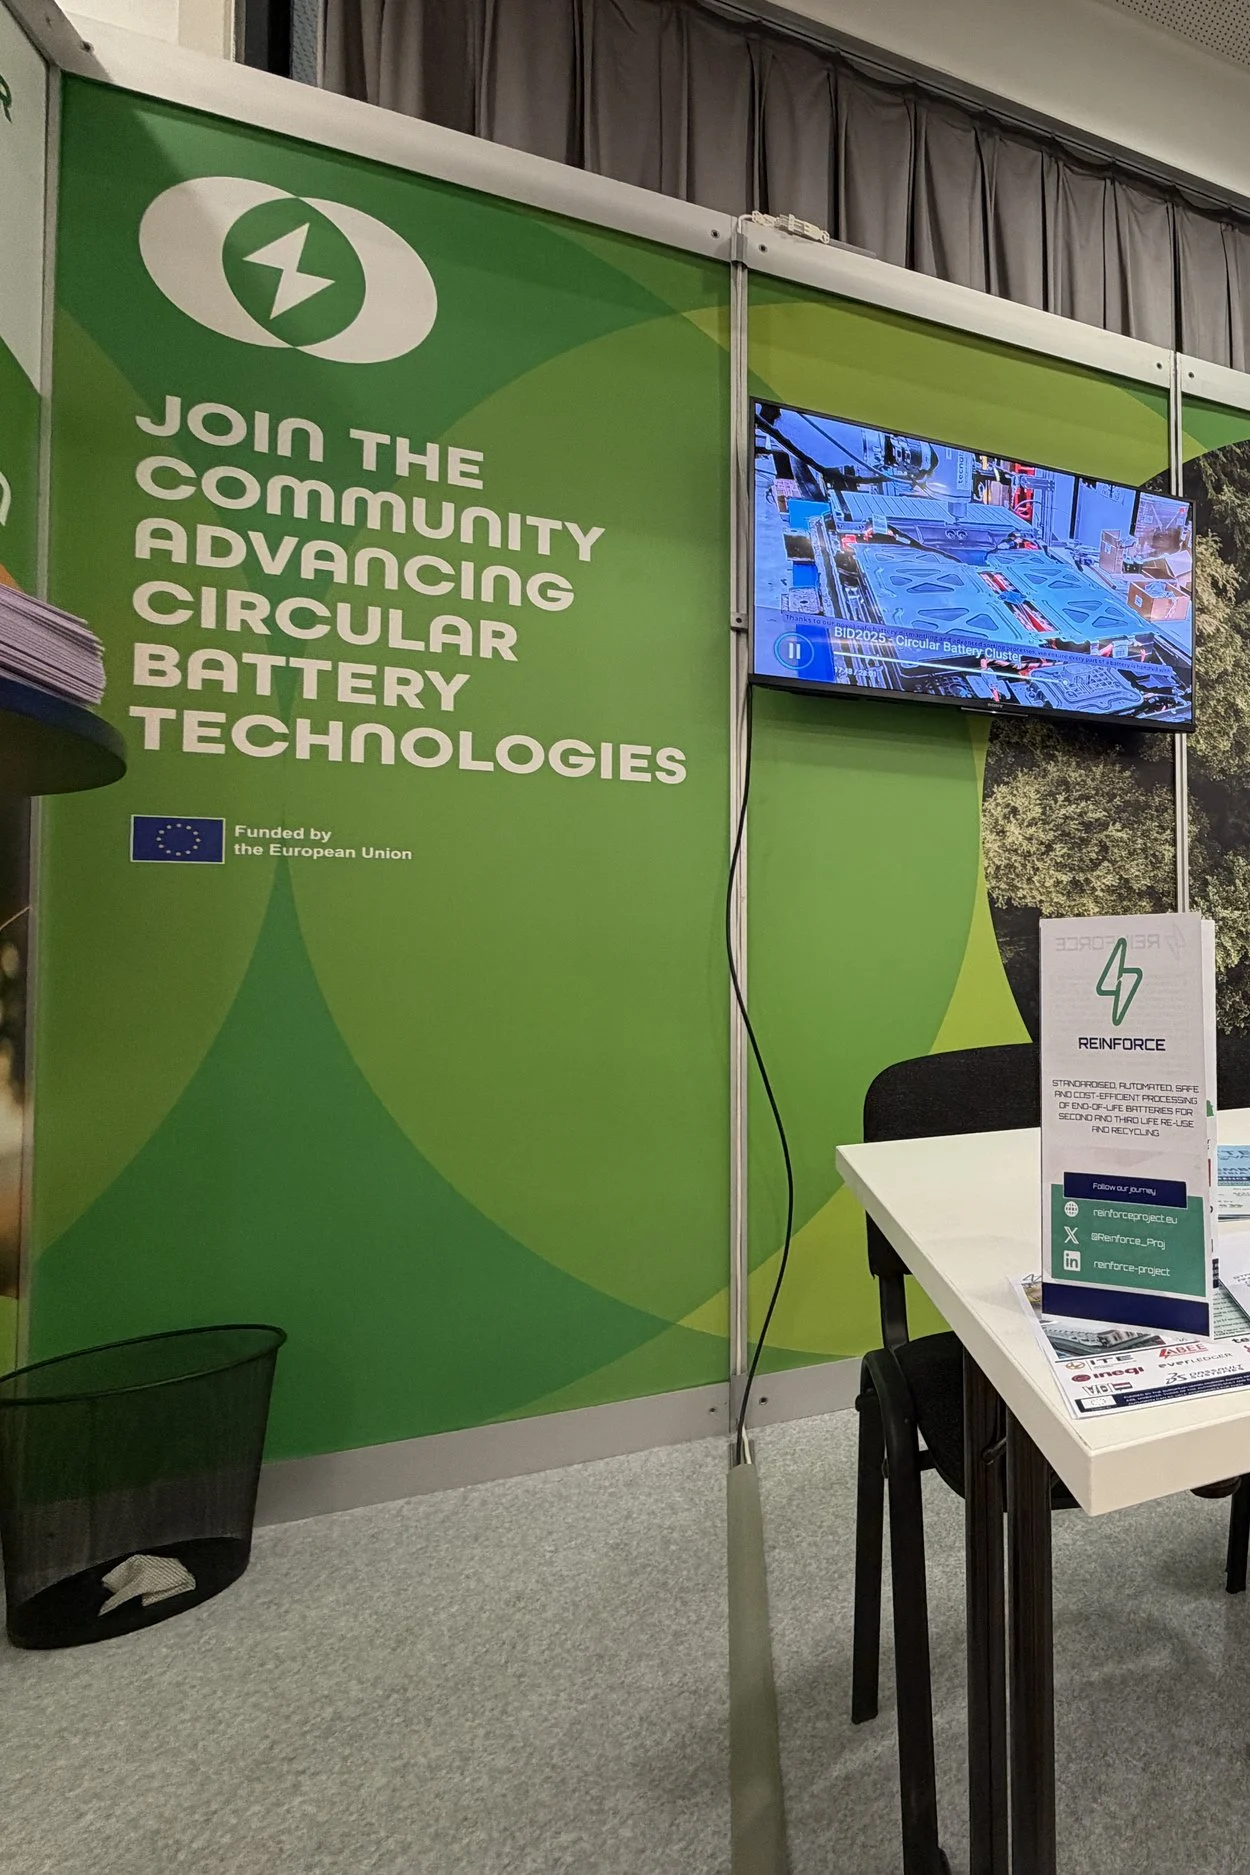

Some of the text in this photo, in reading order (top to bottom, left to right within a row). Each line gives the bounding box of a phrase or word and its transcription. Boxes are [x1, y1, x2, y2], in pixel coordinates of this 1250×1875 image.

[136, 395, 484, 489] JOIN THE
[134, 456, 605, 562] COMMUNITY
[134, 518, 574, 611] ADVANCING
[132, 581, 519, 661] CIRCULAR
[834, 627, 886, 643] BID2025
[896, 635, 940, 651] Circular
[943, 642, 984, 658] Battery
[985, 648, 1022, 662] Cluster
[132, 644, 470, 712] BATTERY
[129, 706, 686, 784] TECHNOLOGIES
[234, 824, 332, 844] Funded by
[234, 842, 412, 860] the European Union
[1079, 1038, 1165, 1051] REINFORCE
[1053, 1080, 1199, 1093] STANDARDISED, AUTOMATED, SAFE
[1074, 1093, 1140, 1101] COST-EFFICIENT
[1142, 1094, 1197, 1104] PROCESSING
[1072, 1103, 1123, 1112] END-OF-LIFE
[1126, 1105, 1173, 1114] BATTERIES
[1176, 1108, 1193, 1116] FOR
[1059, 1113, 1092, 1121] SECOND
[1115, 1116, 1139, 1124] THIRD
[1141, 1117, 1158, 1125] LIFE
[1161, 1119, 1194, 1128] RE-USE
[1112, 1127, 1159, 1136] RECYCLING
[1093, 1183, 1115, 1191] Follow
[1129, 1187, 1156, 1196] journey
[1093, 1208, 1178, 1224] reinforceproject.eu
[1091, 1233, 1165, 1250] @Reinforce_Proj
[1094, 1260, 1170, 1277] reinforce-project
